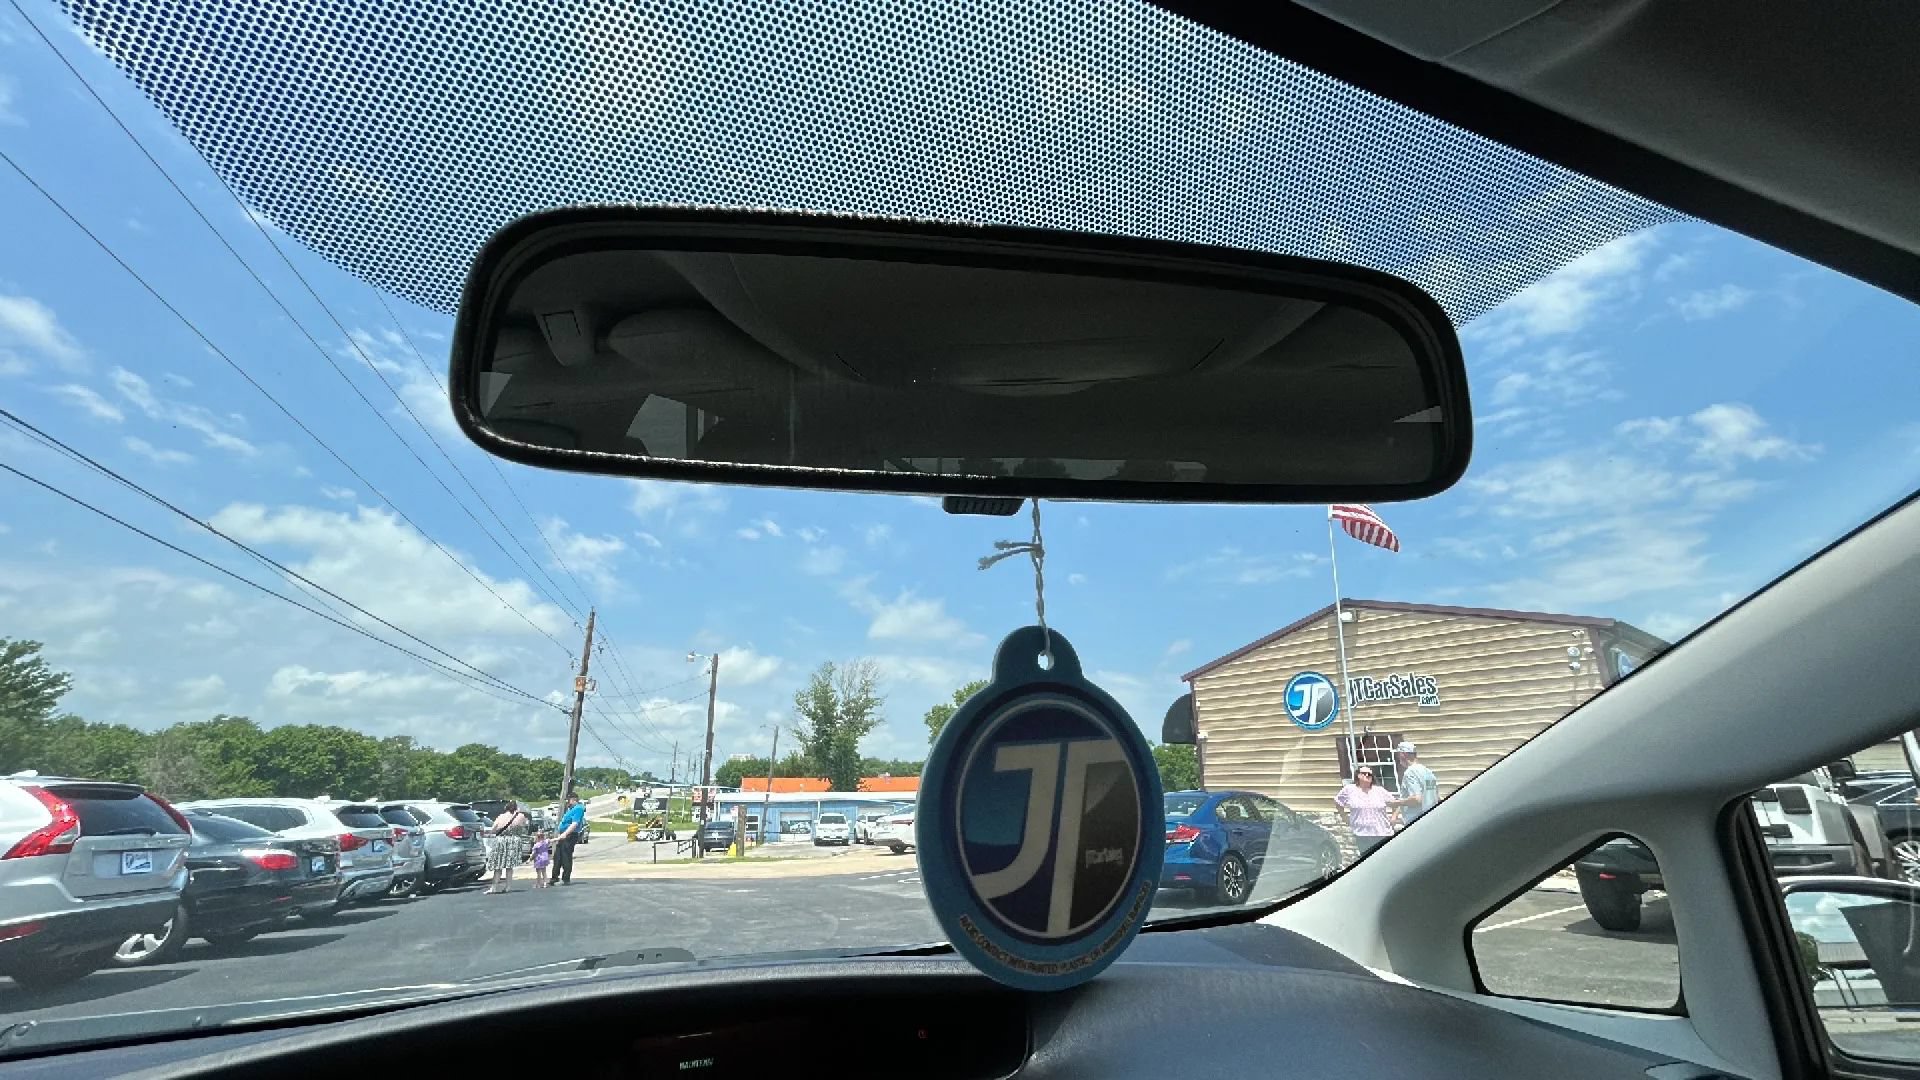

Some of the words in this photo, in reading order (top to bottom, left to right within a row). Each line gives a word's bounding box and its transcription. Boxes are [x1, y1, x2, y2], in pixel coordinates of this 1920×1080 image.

[1290, 682, 1331, 724] JT
[1348, 672, 1438, 706] JTCarSales
[971, 737, 1129, 937] JT
